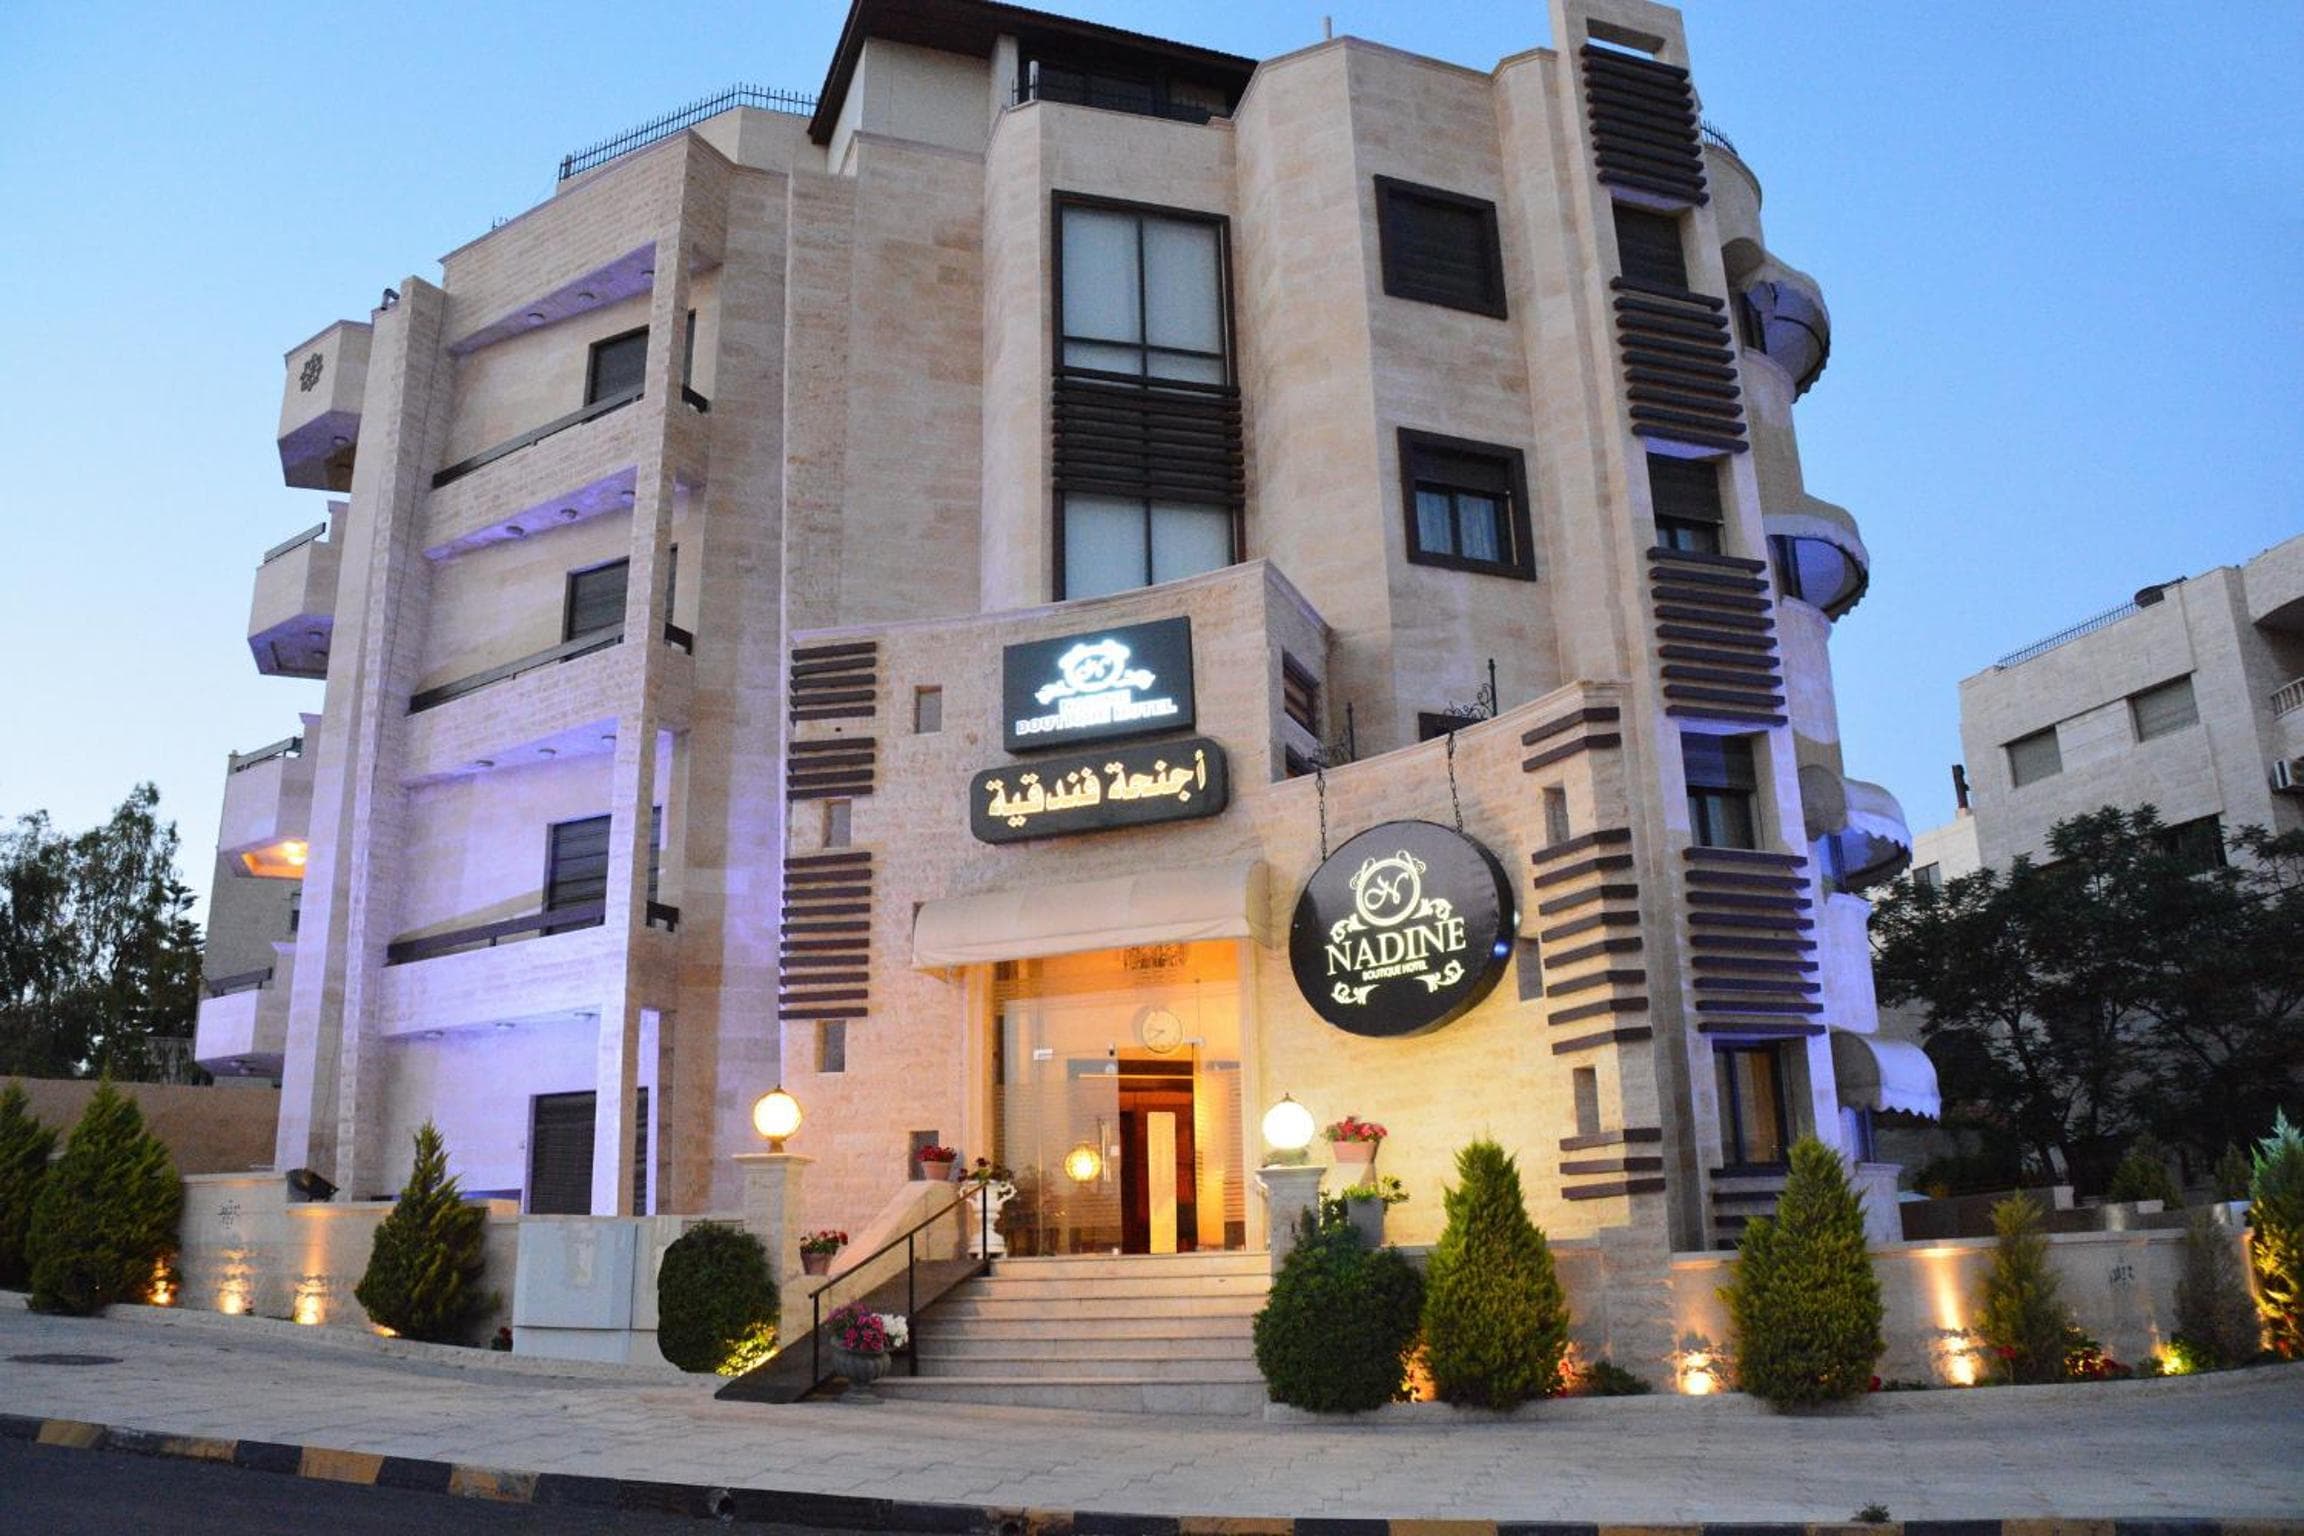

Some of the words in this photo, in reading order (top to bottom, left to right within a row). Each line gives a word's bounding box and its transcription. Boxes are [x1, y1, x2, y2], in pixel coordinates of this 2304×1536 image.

[985, 767, 1100, 828] فندقية
[1104, 749, 1206, 801] أجنحة
[1324, 917, 1467, 976] NADINE
[1362, 964, 1401, 982] BOUTIQUE
[1402, 960, 1429, 974] HOTEL
